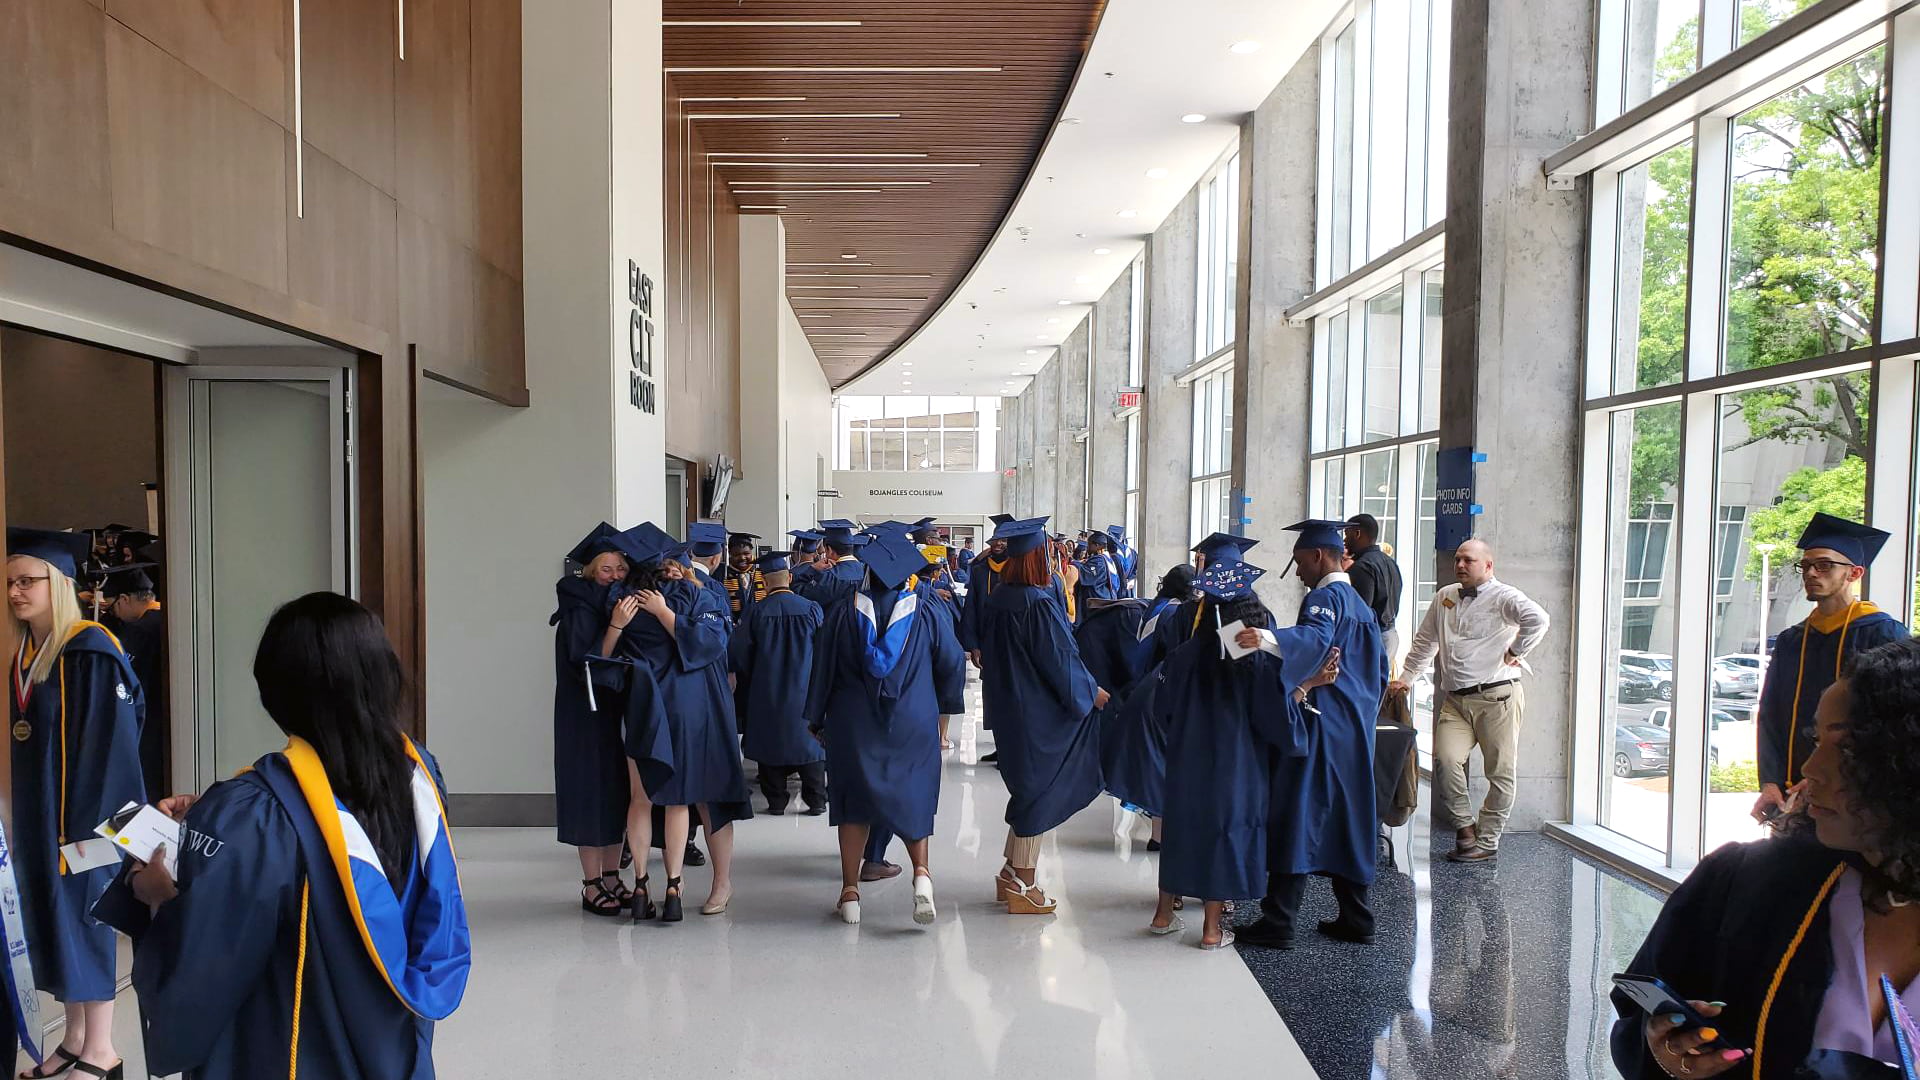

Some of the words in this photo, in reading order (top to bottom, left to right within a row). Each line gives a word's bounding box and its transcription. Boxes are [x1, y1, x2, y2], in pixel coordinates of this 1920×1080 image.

[629, 258, 654, 318] EAST
[630, 309, 654, 378] CLT
[630, 370, 655, 415] ROOM
[1120, 393, 1138, 407] EXIT
[1436, 488, 1455, 501] PHOTO
[1456, 487, 1471, 500] INFO
[1442, 502, 1463, 515] CARDS
[702, 612, 718, 621] JWU
